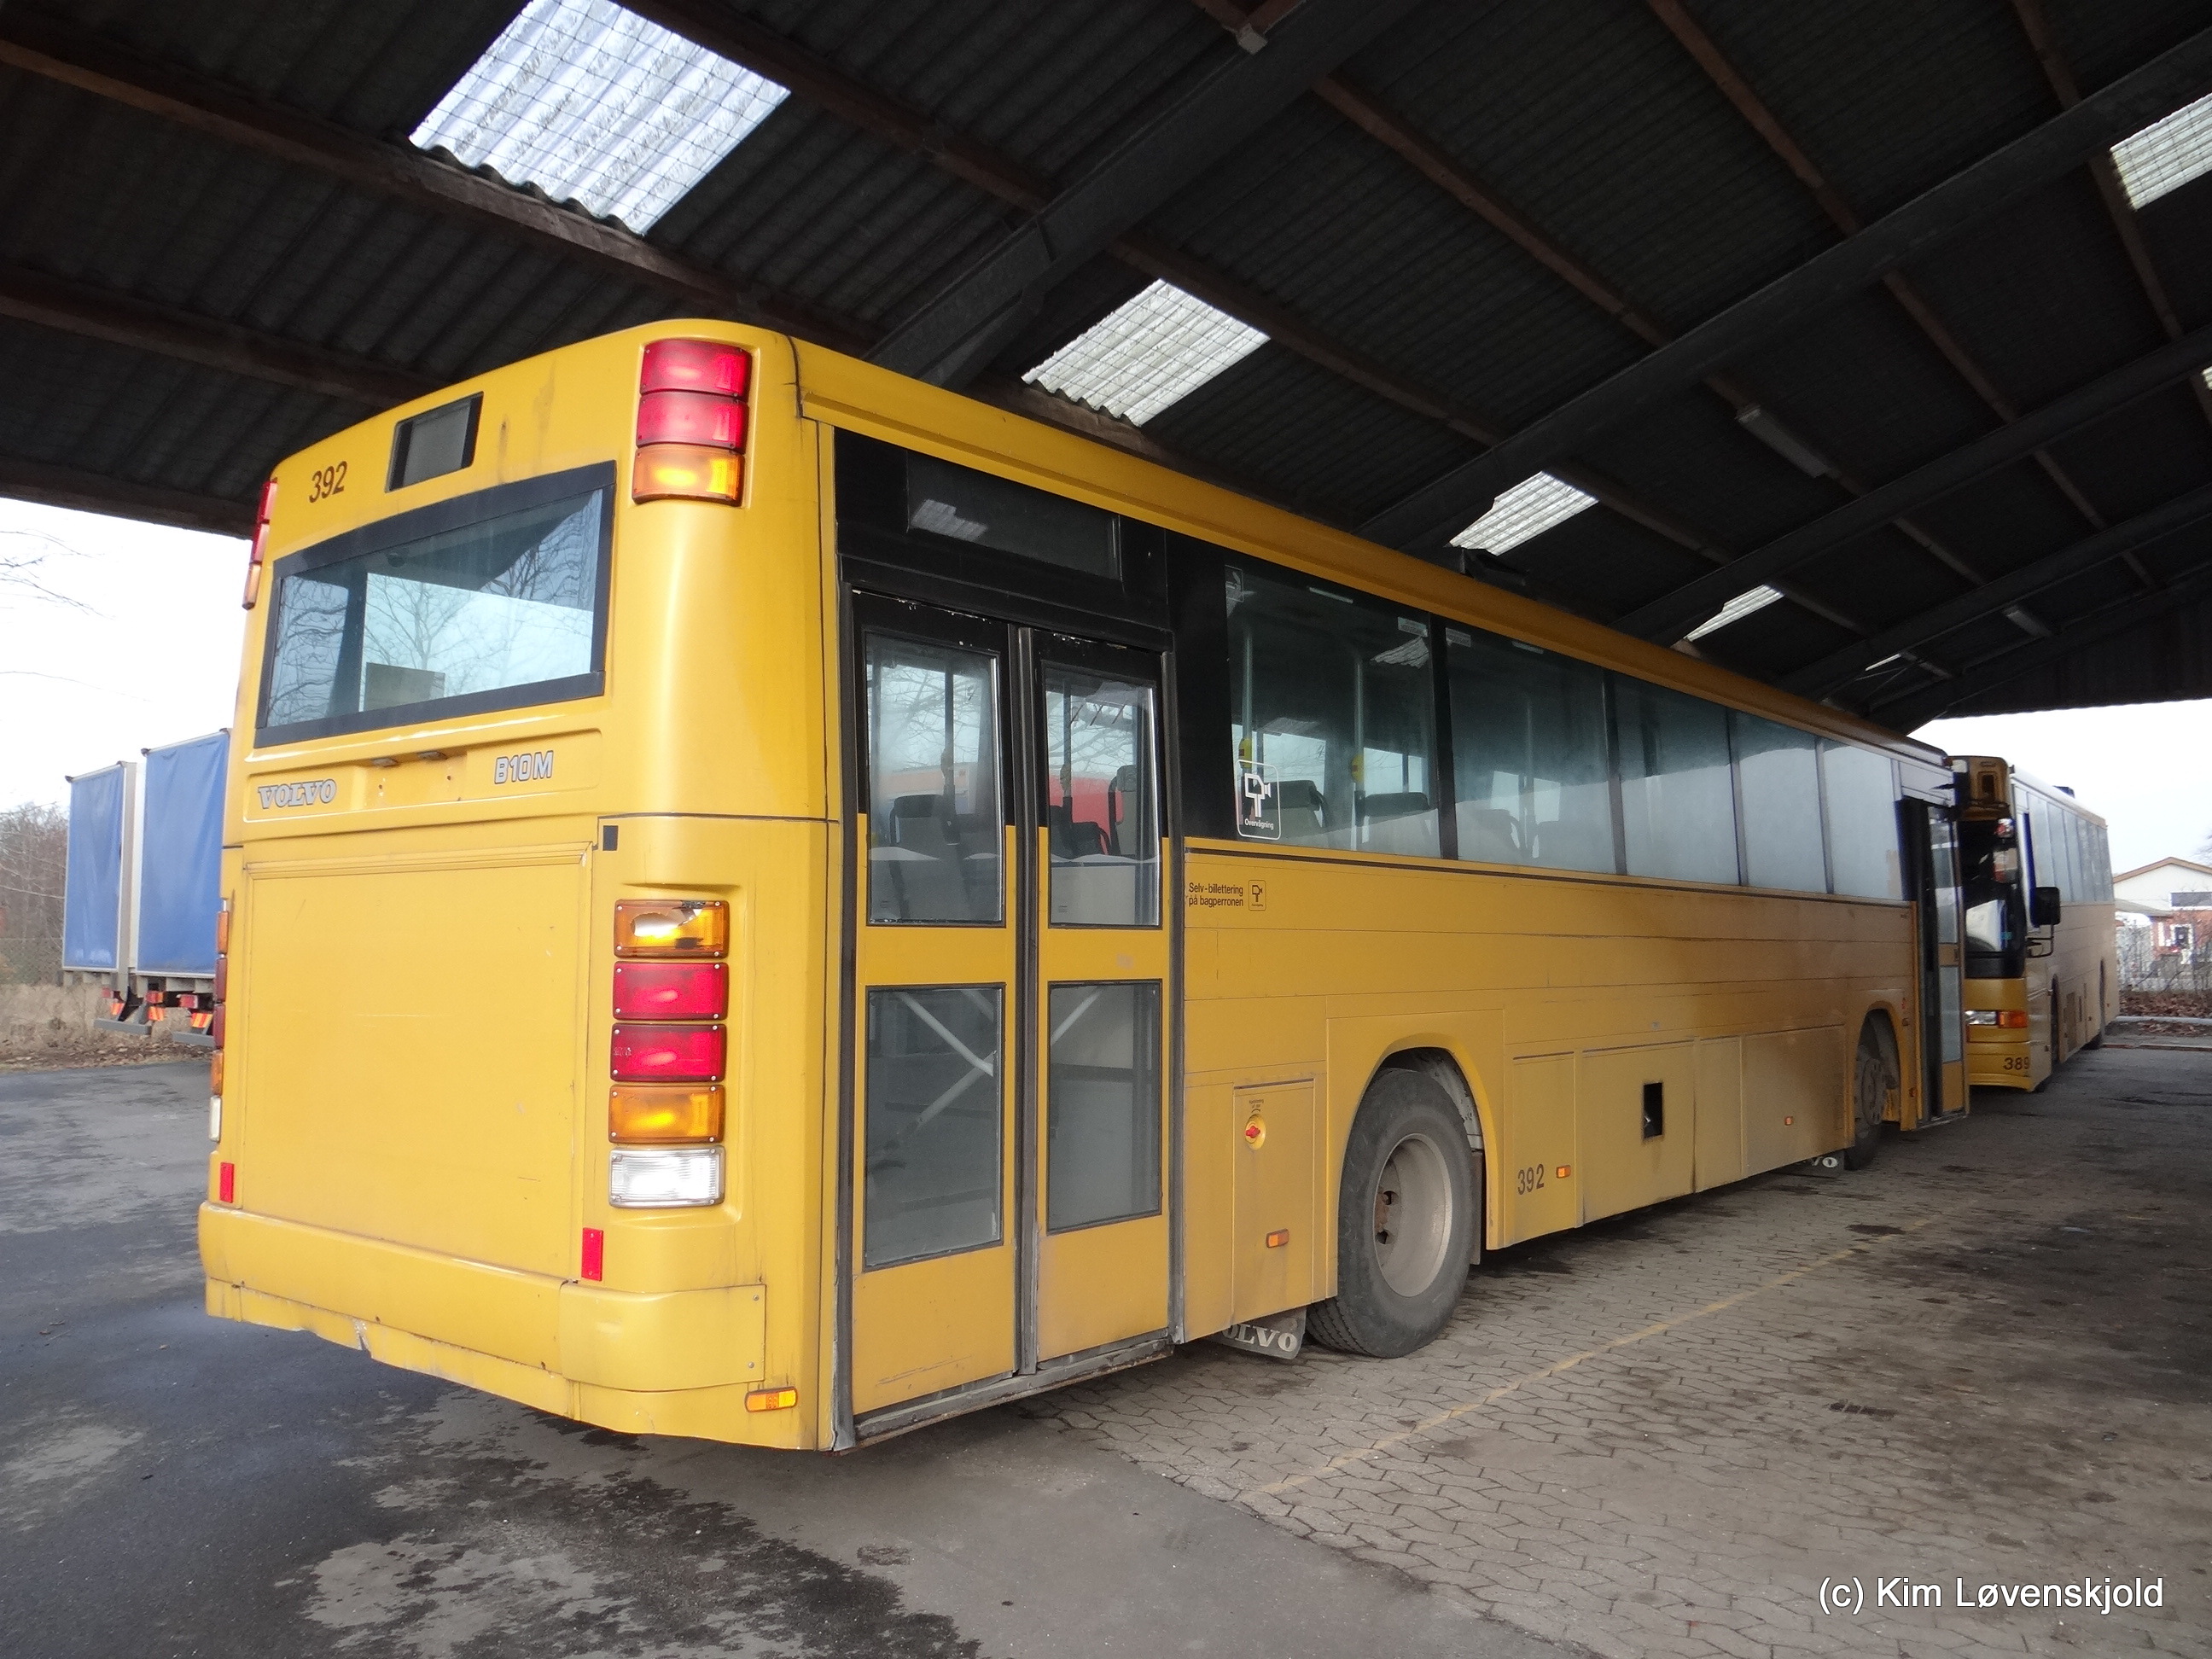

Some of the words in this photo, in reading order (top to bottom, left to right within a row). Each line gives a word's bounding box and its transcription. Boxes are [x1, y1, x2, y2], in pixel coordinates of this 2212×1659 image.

[309, 461, 347, 503] 392
[494, 750, 554, 784] B10M
[258, 778, 337, 809] VOLVO
[1244, 818, 1274, 830] Overvågning
[1189, 894, 1198, 908] på
[1200, 896, 1243, 908] bagperronen
[1517, 1163, 1545, 1195] 392
[1221, 1324, 1298, 1353] OLVO
